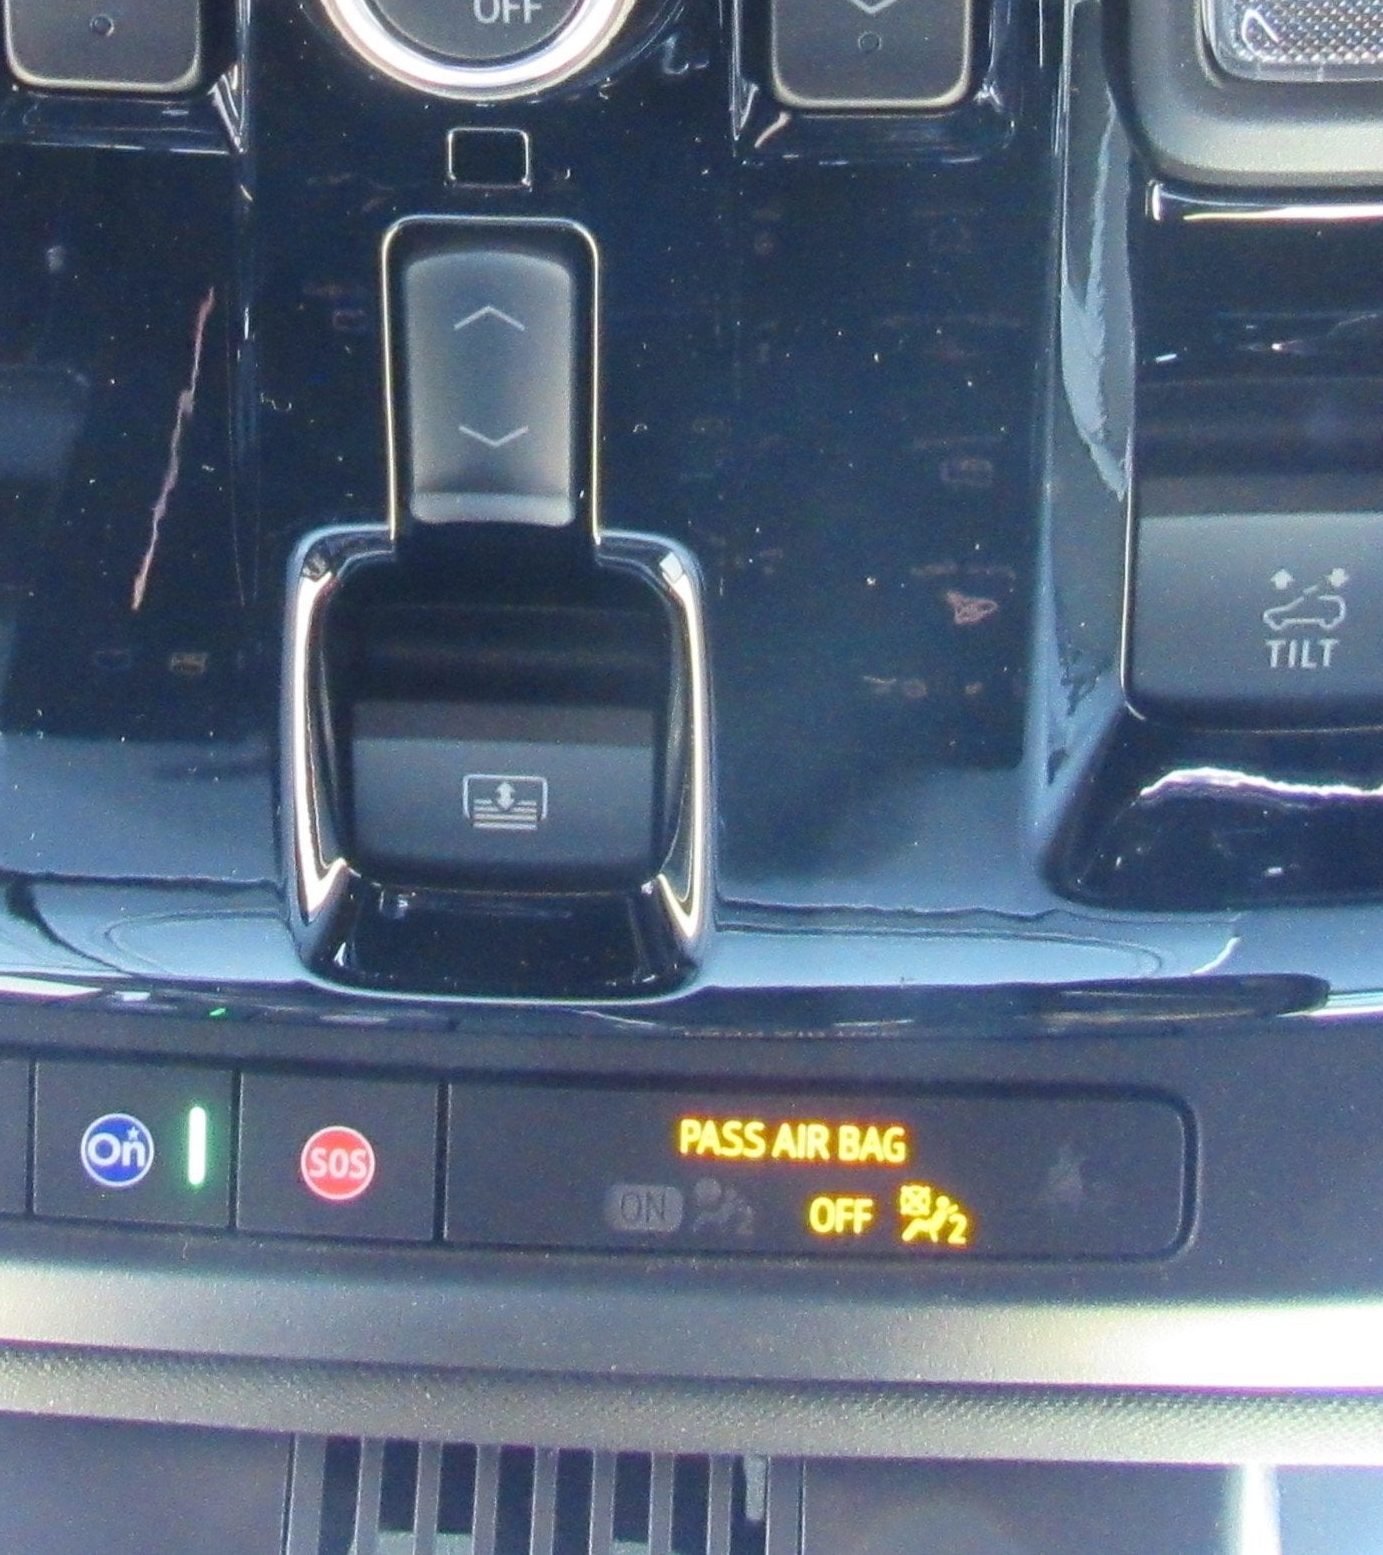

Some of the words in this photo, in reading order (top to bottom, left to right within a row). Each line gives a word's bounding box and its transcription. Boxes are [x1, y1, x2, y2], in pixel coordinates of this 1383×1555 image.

[1265, 638, 1340, 669] TILT
[679, 1117, 767, 1159] PASS
[770, 1121, 831, 1161] AIR
[837, 1124, 907, 1164] BAG
[308, 1146, 368, 1180] SOS
[620, 1191, 666, 1224] ON
[809, 1195, 874, 1234] OFF
